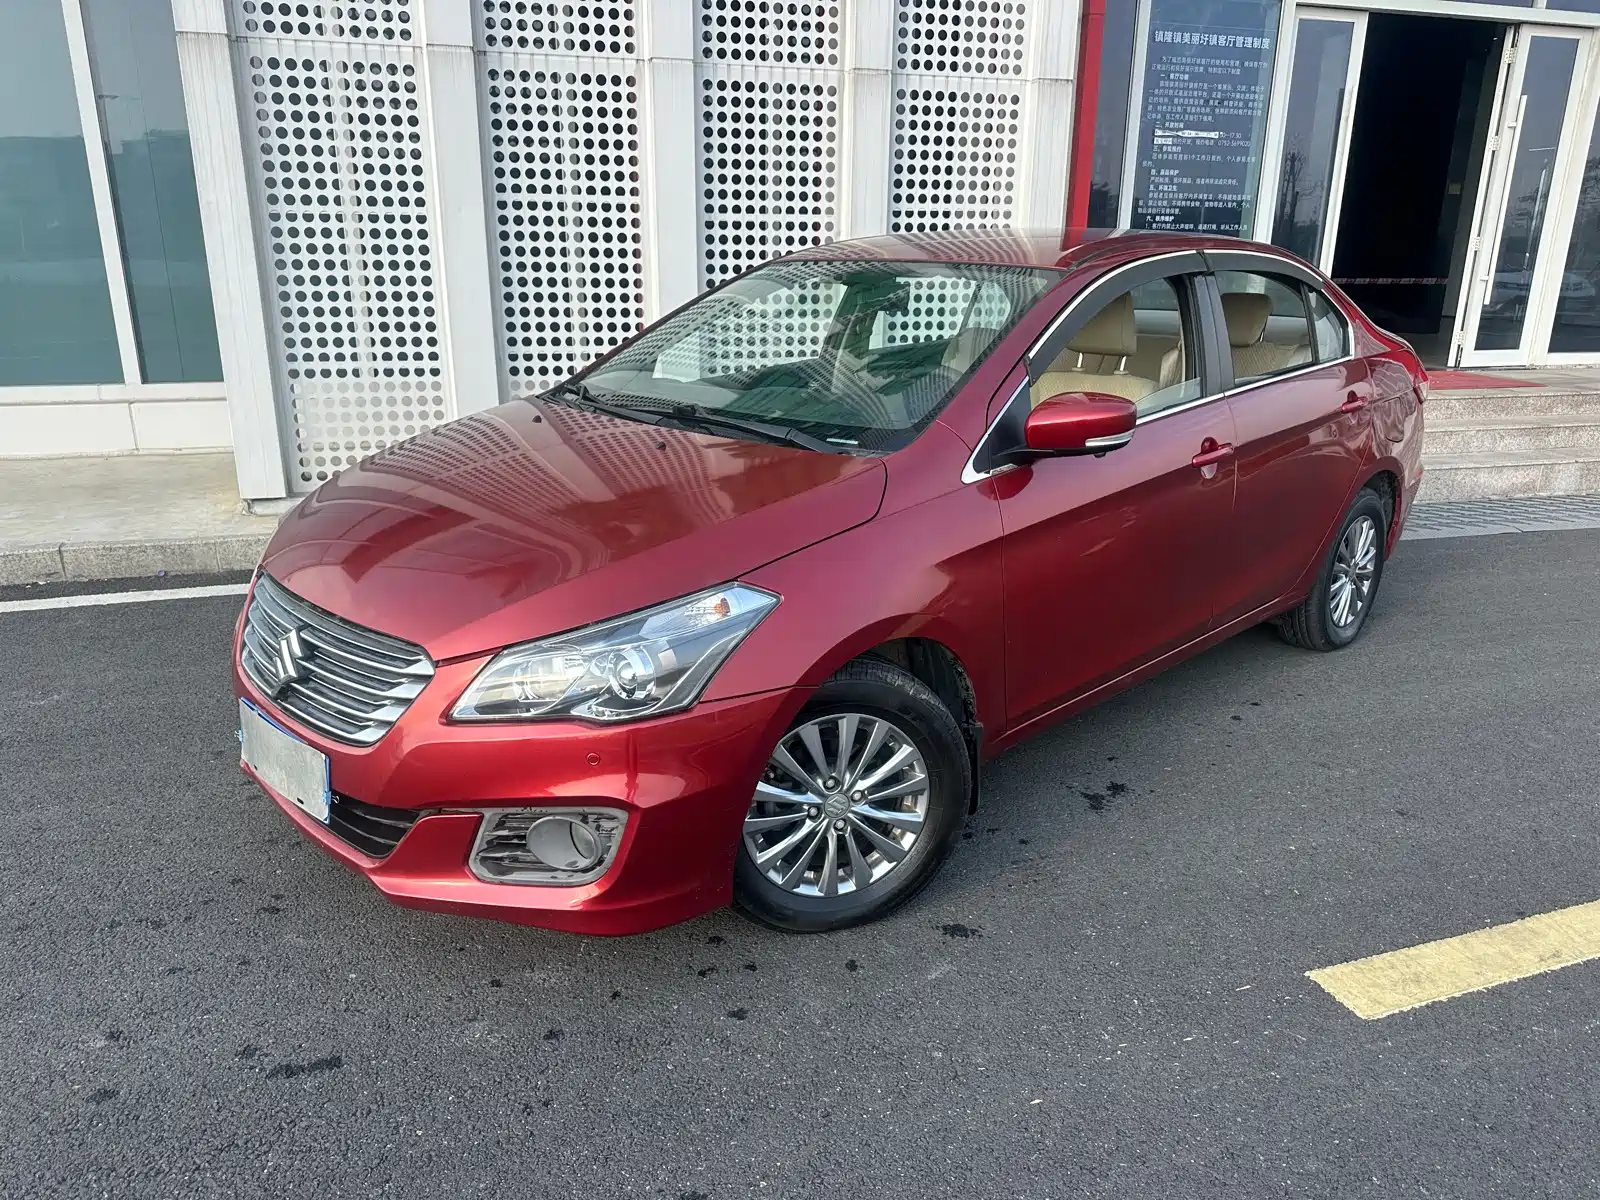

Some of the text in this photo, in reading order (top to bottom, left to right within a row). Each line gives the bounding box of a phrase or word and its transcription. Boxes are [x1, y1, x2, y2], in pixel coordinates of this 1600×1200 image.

[1155, 31, 1270, 49] 镇隆镇美丽圩镇客厅管理制度
